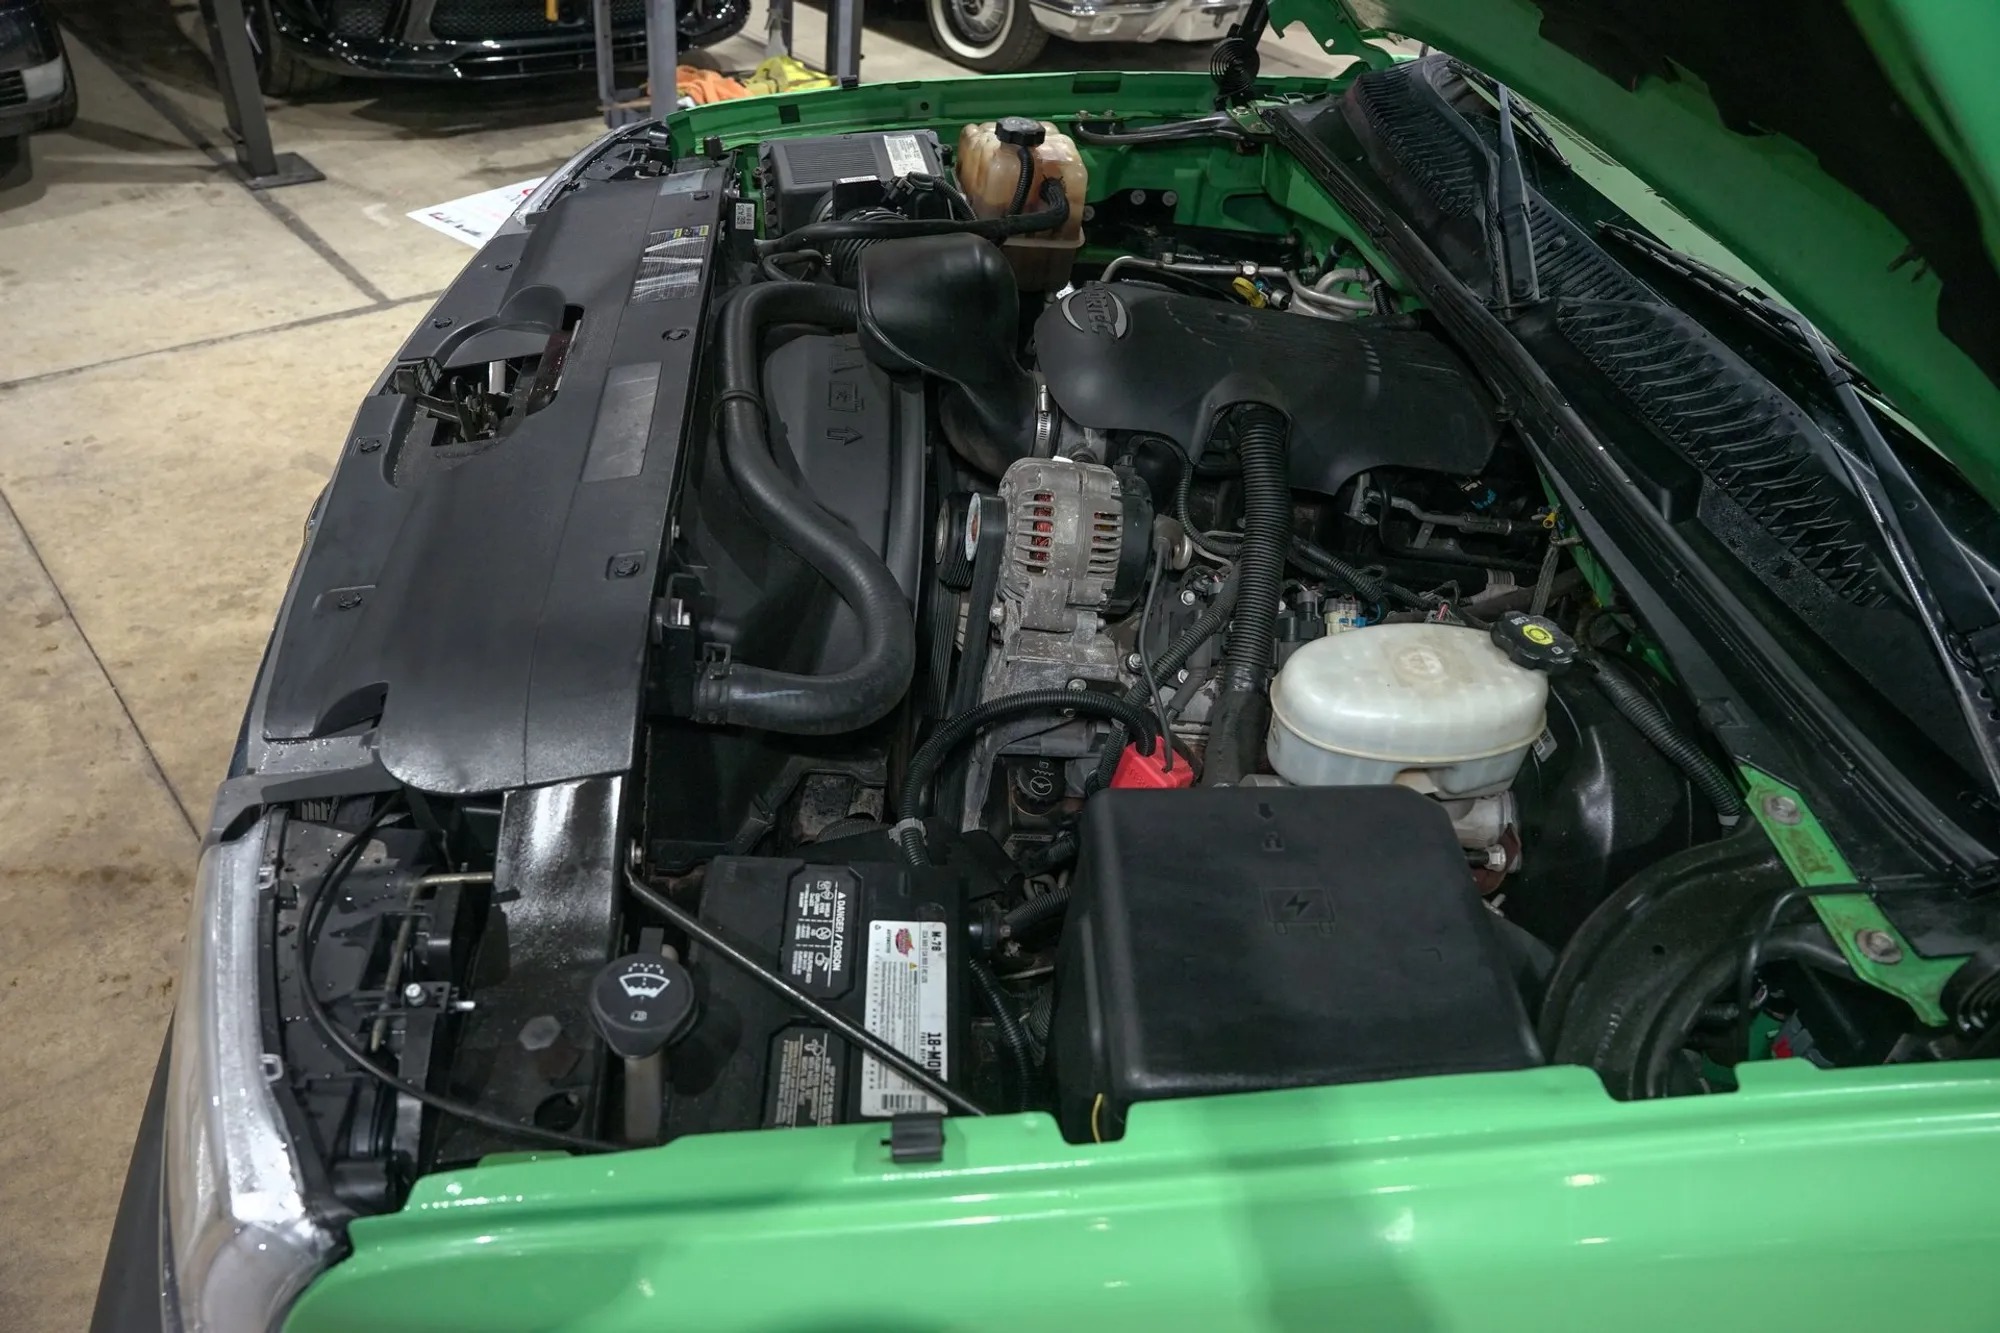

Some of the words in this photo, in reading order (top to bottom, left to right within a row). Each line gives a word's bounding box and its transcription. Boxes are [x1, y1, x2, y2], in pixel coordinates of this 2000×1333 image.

[1085, 281, 1116, 338] VORTEC
[835, 900, 846, 932] DANGER
[832, 940, 843, 971] POISON
